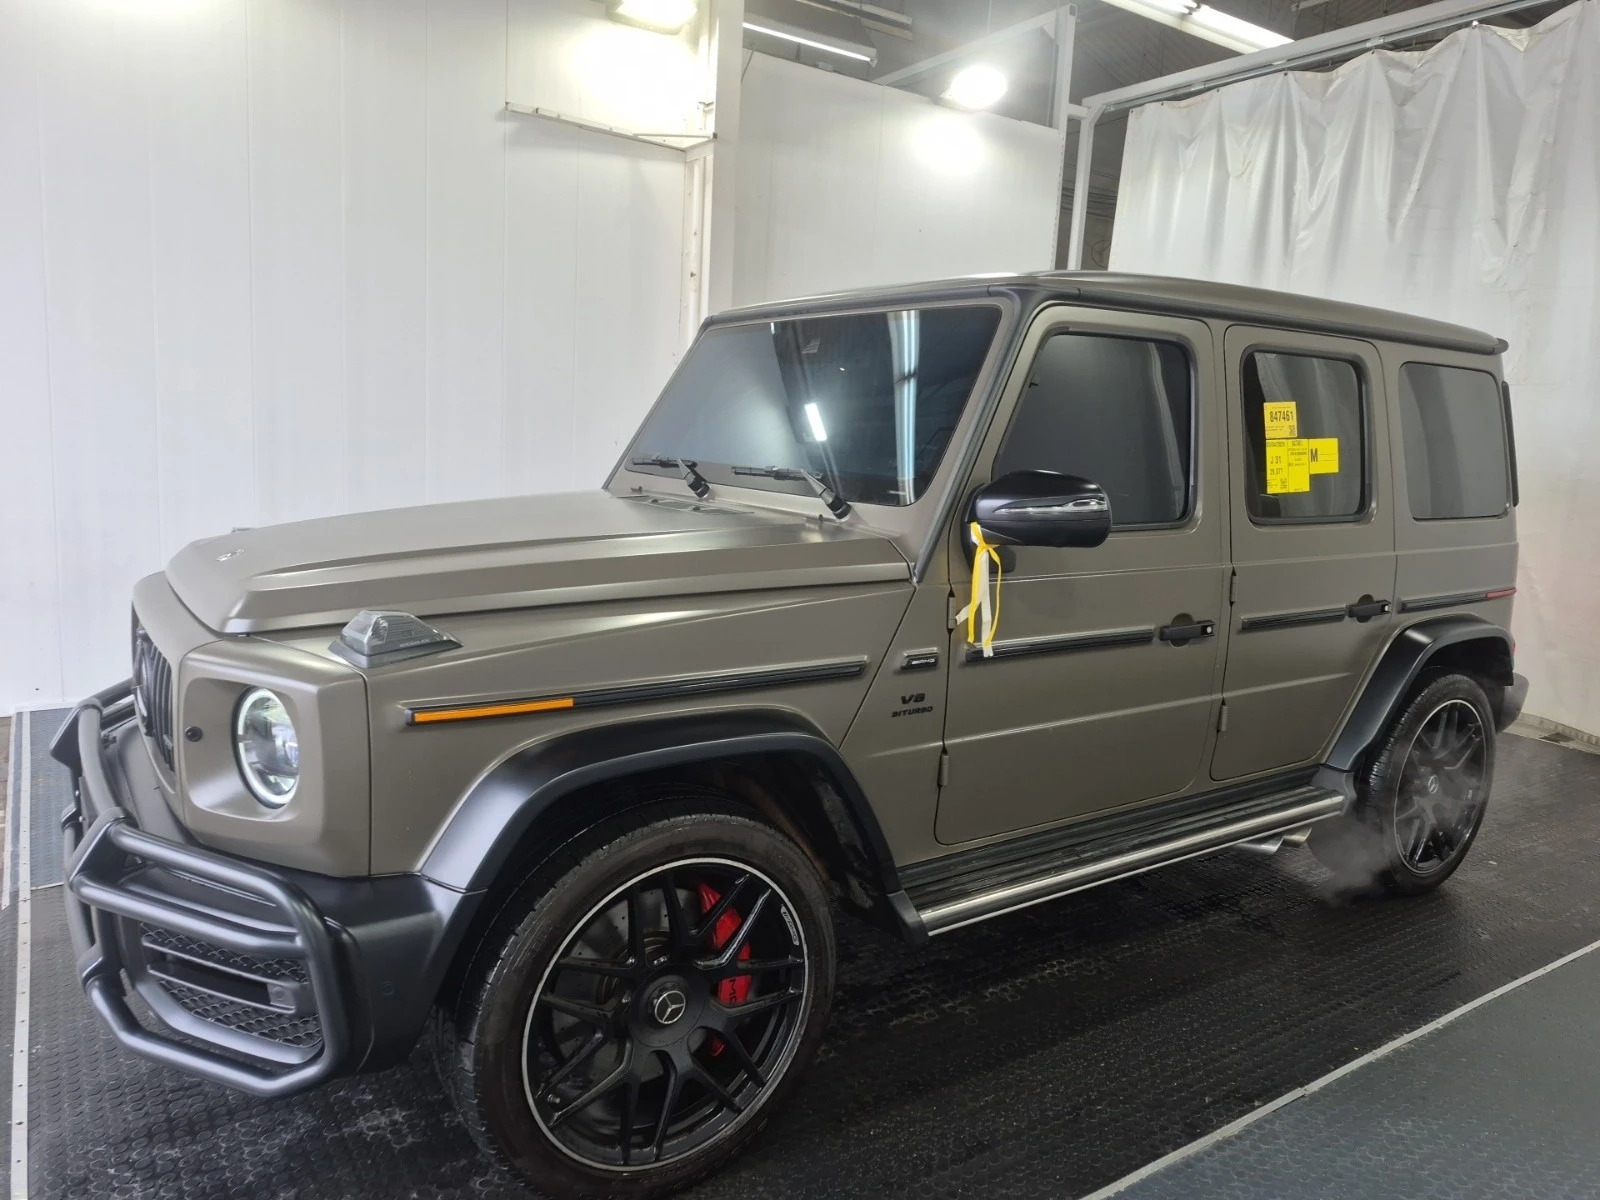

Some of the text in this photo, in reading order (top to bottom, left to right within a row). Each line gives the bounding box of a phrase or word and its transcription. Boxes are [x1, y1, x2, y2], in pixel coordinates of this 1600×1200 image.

[1269, 410, 1294, 423] 847461
[1310, 448, 1319, 462] M
[900, 692, 926, 705] V8
[891, 706, 934, 718] BITURBO
